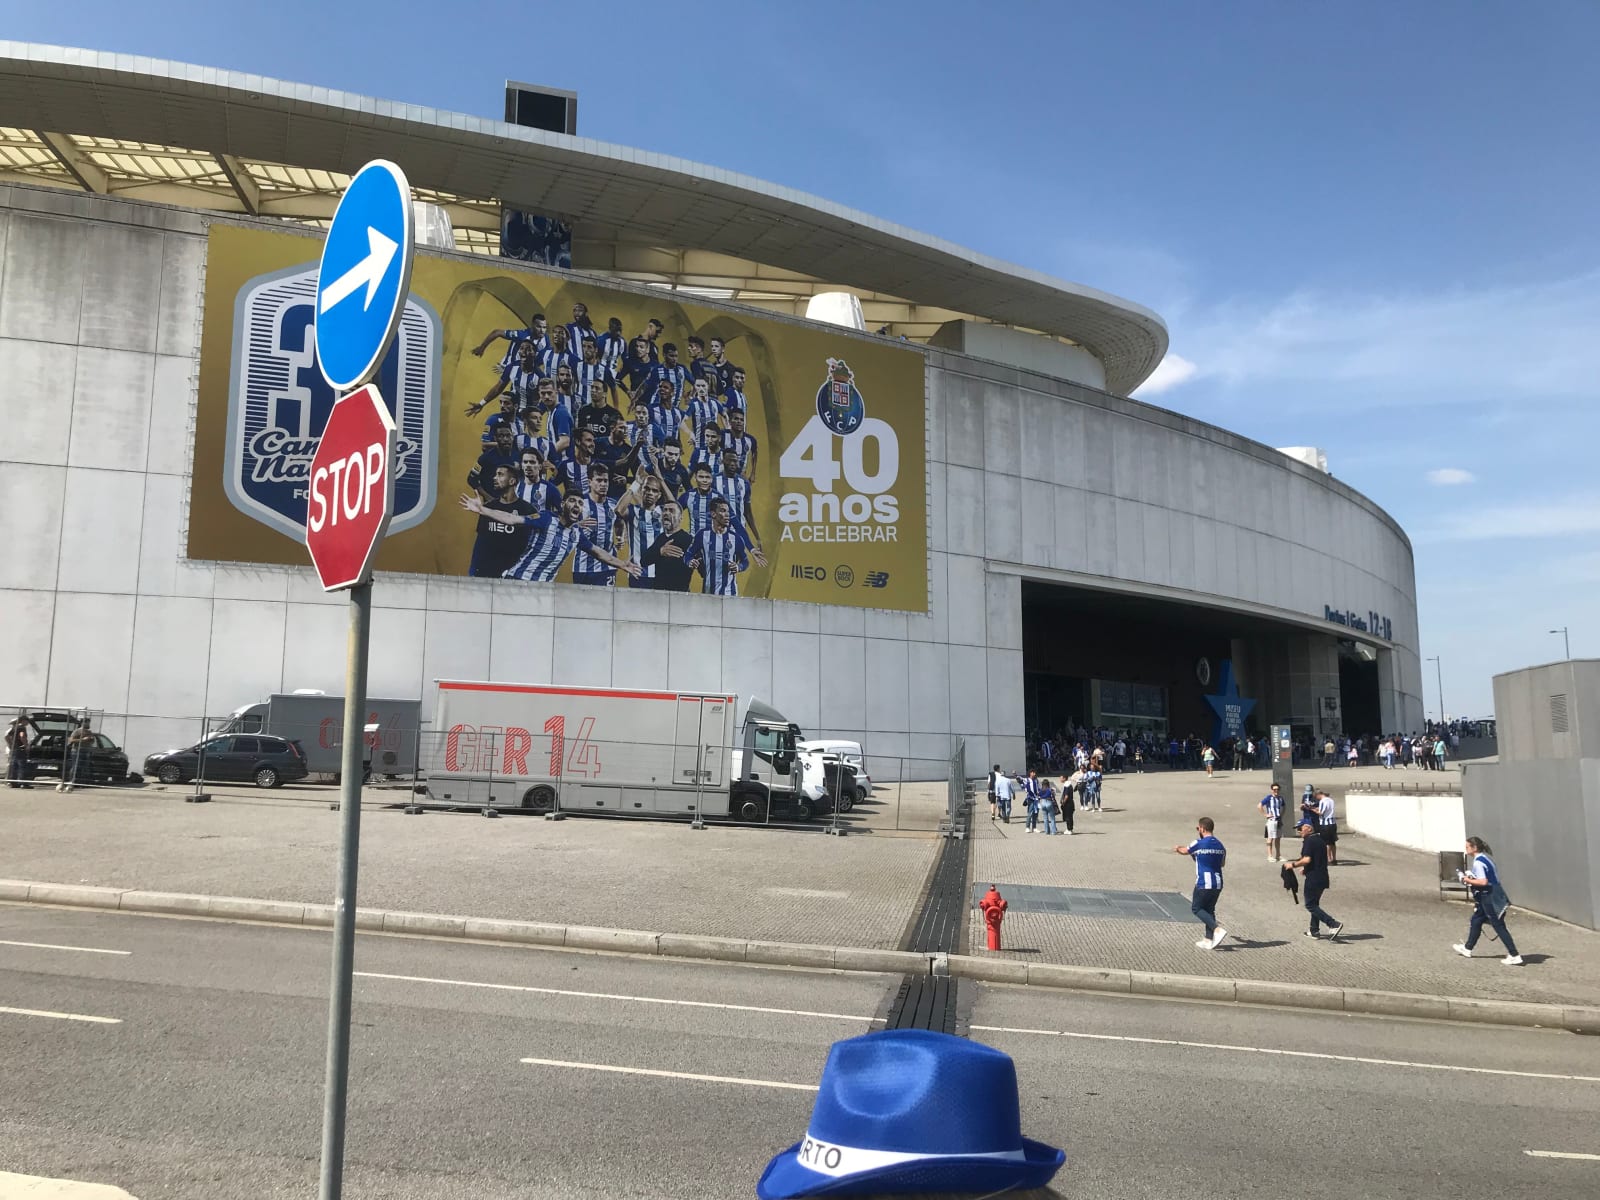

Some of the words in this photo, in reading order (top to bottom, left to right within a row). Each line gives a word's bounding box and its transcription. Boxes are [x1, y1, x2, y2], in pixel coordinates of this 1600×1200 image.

[780, 415, 899, 494] 40
[310, 442, 385, 532] STOP
[778, 492, 899, 523] anos
[780, 525, 794, 542] A
[799, 525, 898, 543] CELEBRAR
[445, 724, 532, 775] GER
[544, 715, 602, 778] 14
